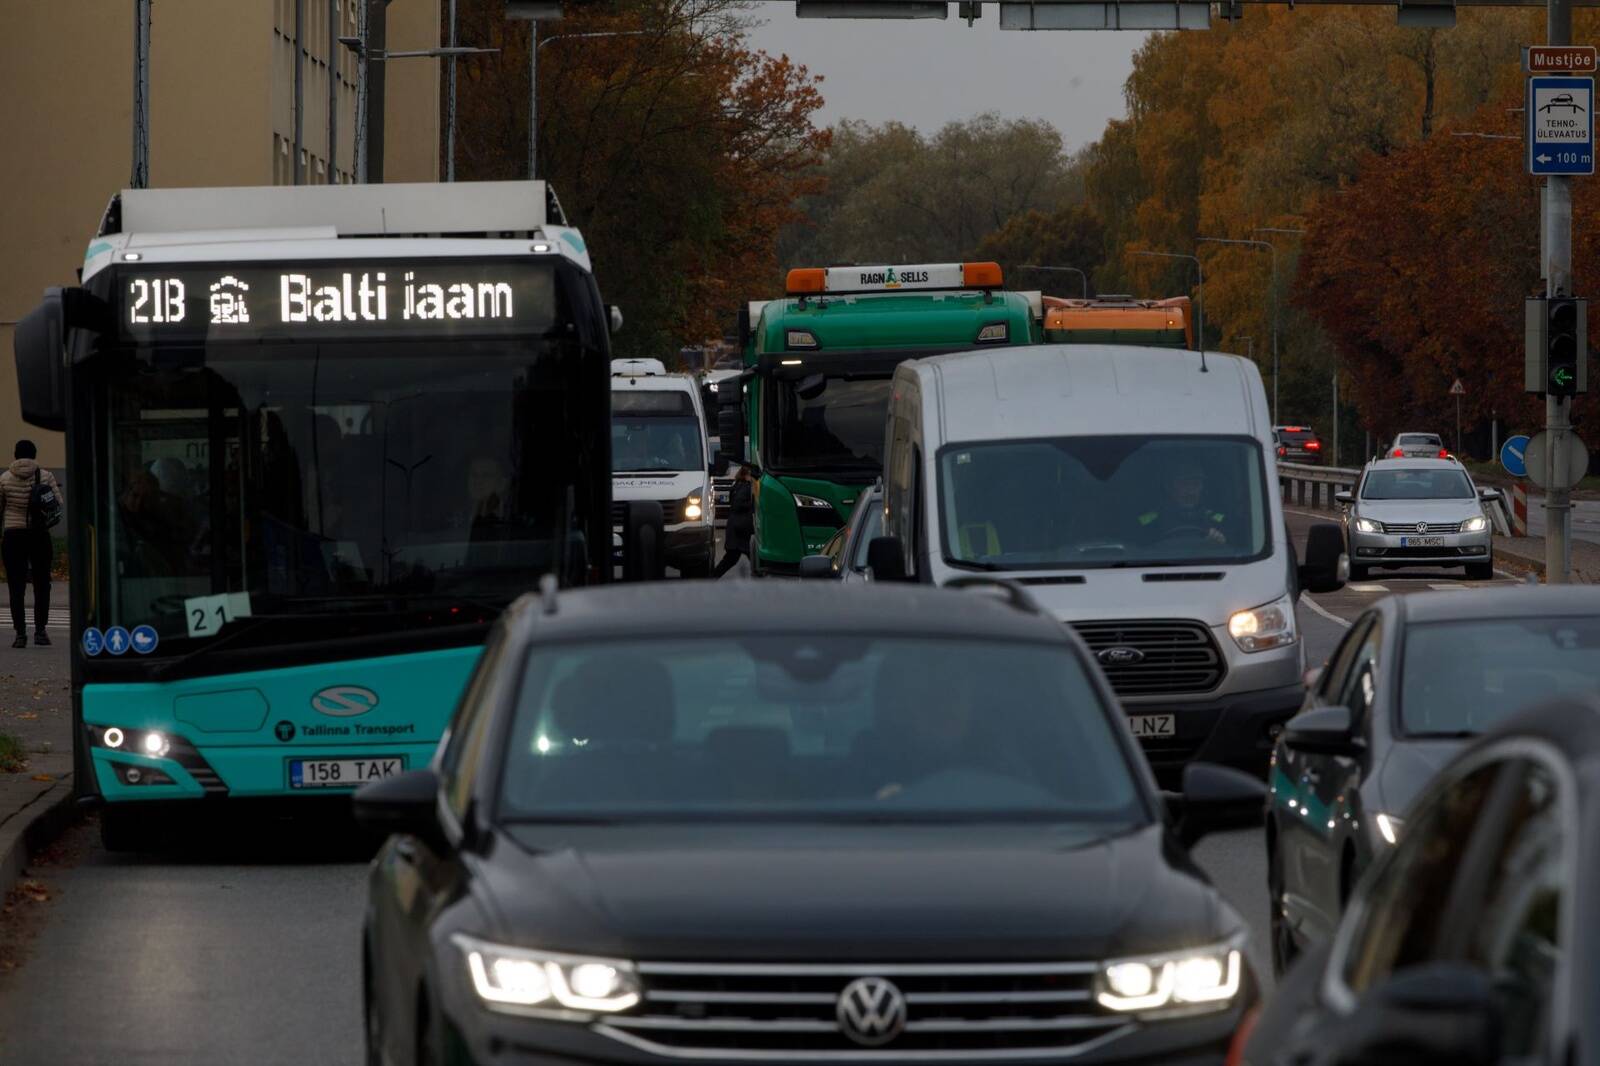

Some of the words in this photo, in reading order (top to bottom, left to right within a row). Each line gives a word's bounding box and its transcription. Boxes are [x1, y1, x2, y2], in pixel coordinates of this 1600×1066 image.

[1546, 119, 1578, 128] TEHNO-
[1537, 129, 1587, 138] ÜLEVAATUS
[1556, 153, 1577, 163] 100
[1581, 154, 1590, 163] m
[860, 273, 885, 285] RAGN
[900, 272, 928, 284] SELLS
[130, 278, 185, 323] 21B
[280, 272, 387, 322] Balti
[302, 726, 350, 736] Tallinna
[354, 723, 414, 735] Transport
[309, 763, 341, 781] 158
